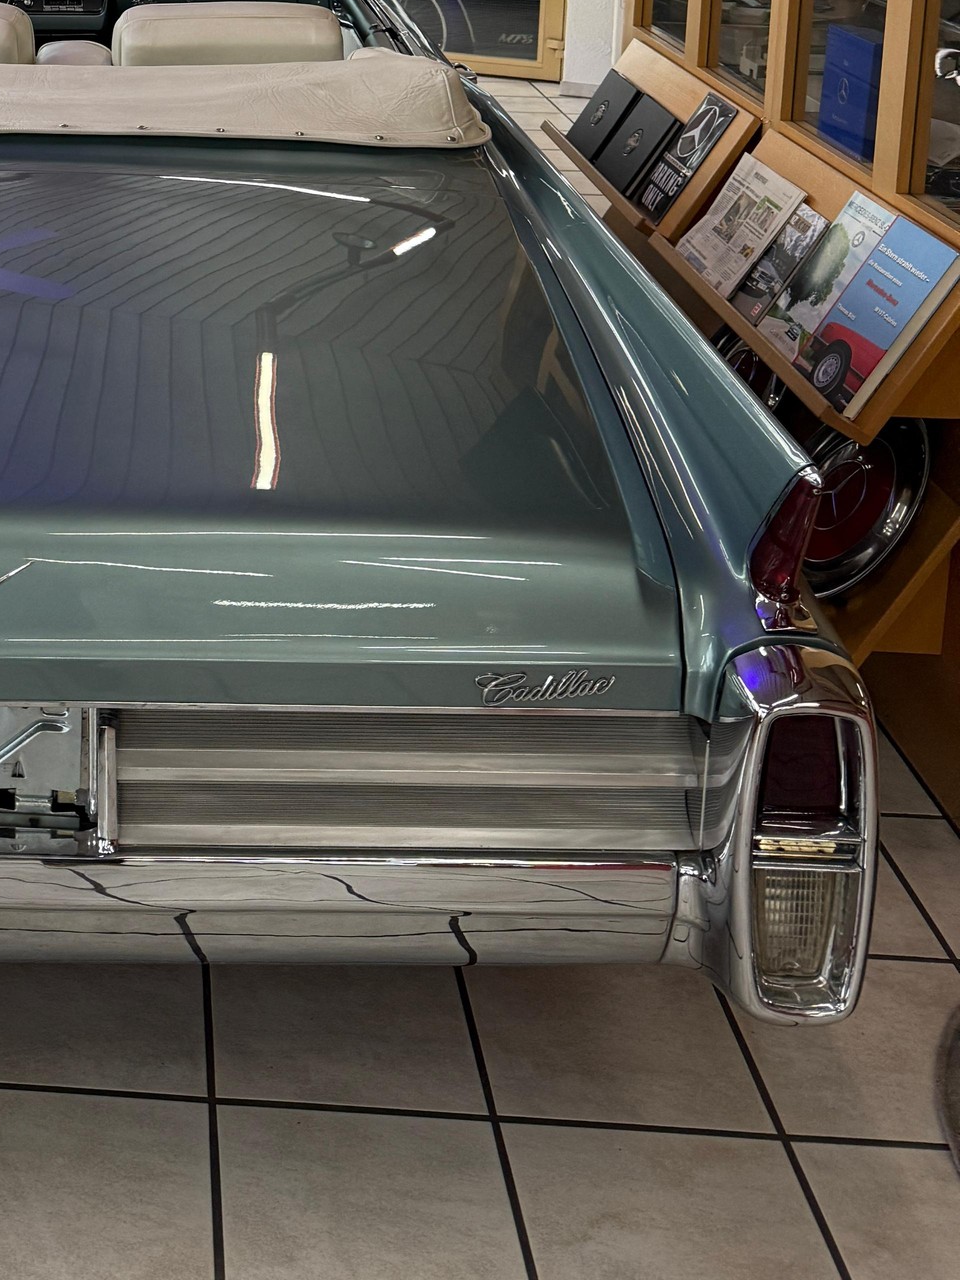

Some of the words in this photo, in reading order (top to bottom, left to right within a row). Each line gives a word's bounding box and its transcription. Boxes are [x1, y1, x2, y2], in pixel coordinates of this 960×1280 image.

[641, 183, 665, 212] ONLY
[847, 200, 882, 227] MERCEDES-BENZ
[878, 243, 888, 254] Ein
[885, 247, 899, 262] Stern
[896, 256, 913, 271] strahlt
[910, 266, 927, 282] wieder
[474, 669, 616, 707] Cadillac
